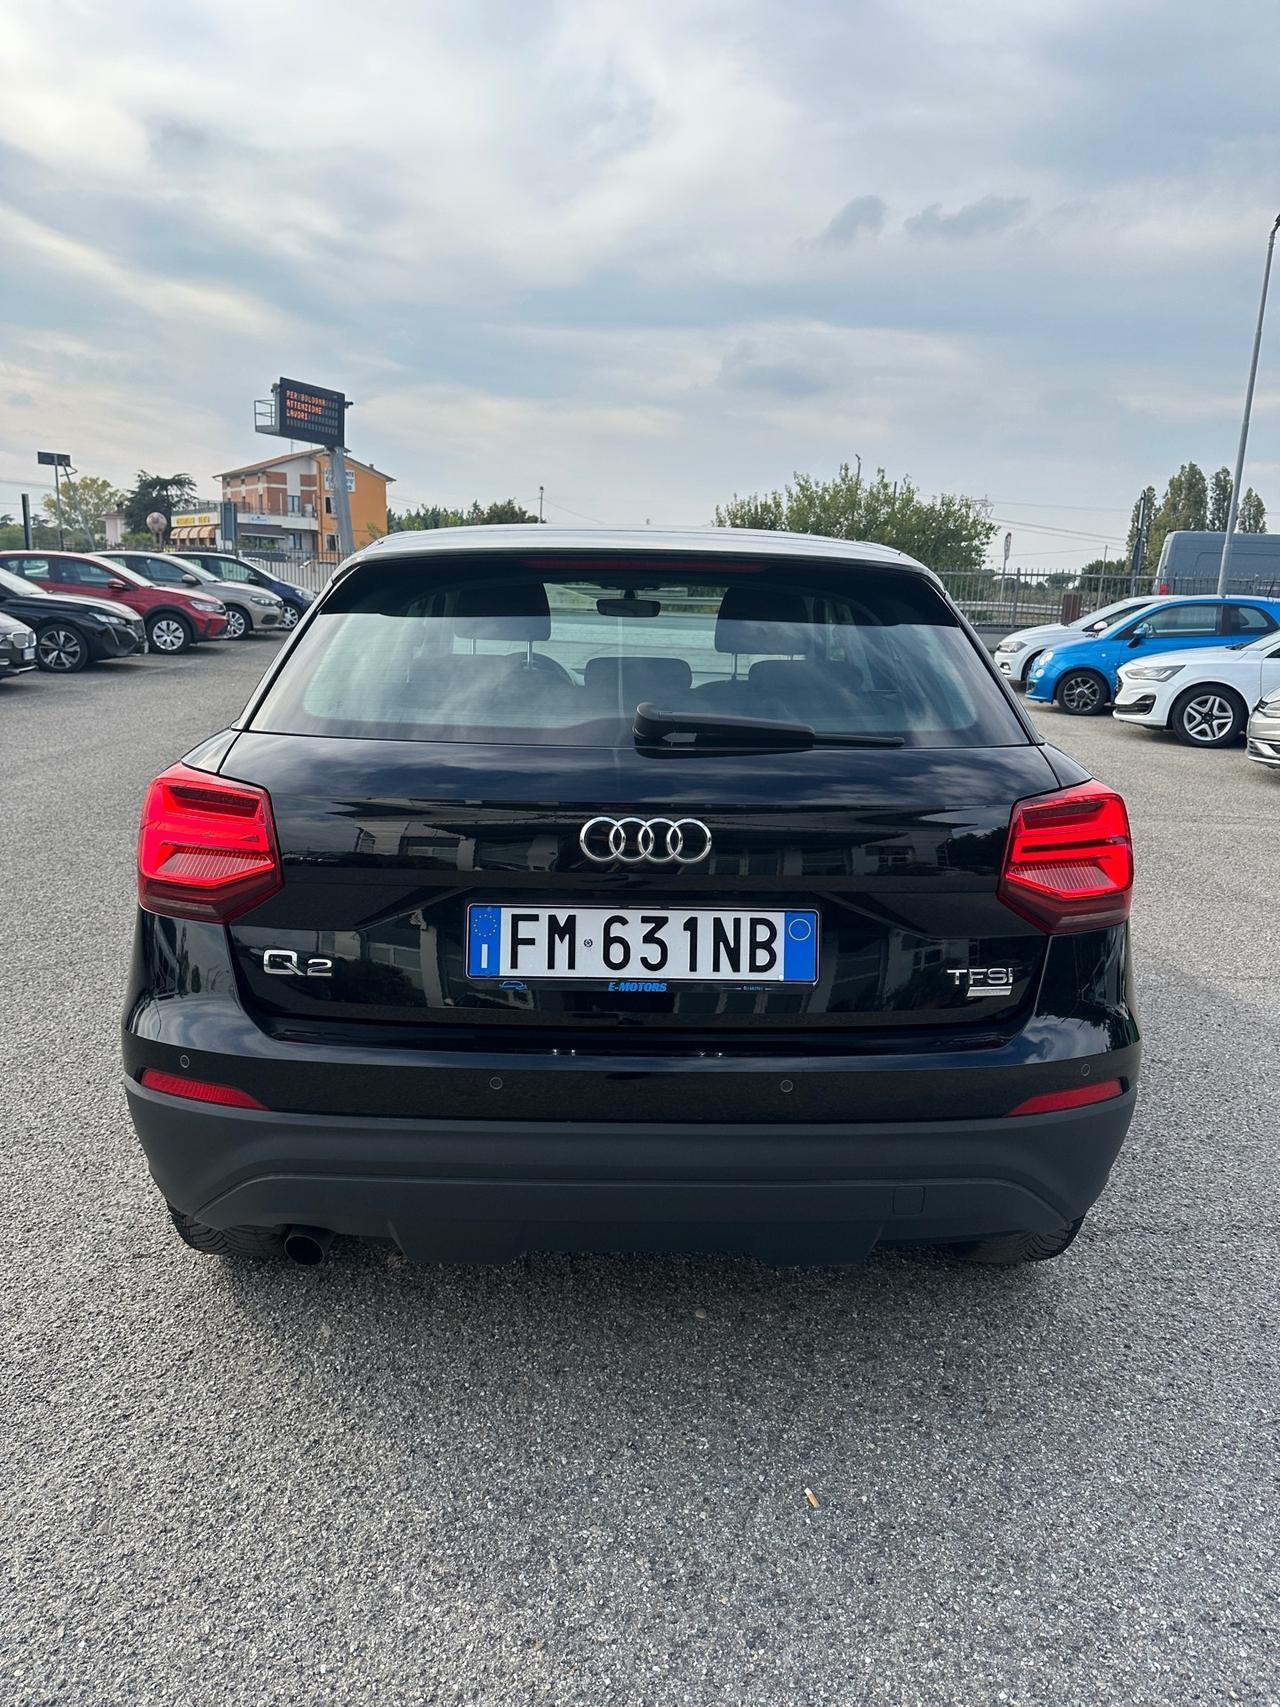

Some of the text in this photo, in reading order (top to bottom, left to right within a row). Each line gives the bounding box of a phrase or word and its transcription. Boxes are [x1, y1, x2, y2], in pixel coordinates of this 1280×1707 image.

[286, 390, 297, 400] PER
[286, 399, 322, 415] ATTENZIONE
[286, 409, 308, 421] LAVORI
[510, 914, 778, 973] FM 631NB
[264, 950, 332, 976] Q2
[608, 982, 667, 992] E-MOTORS
